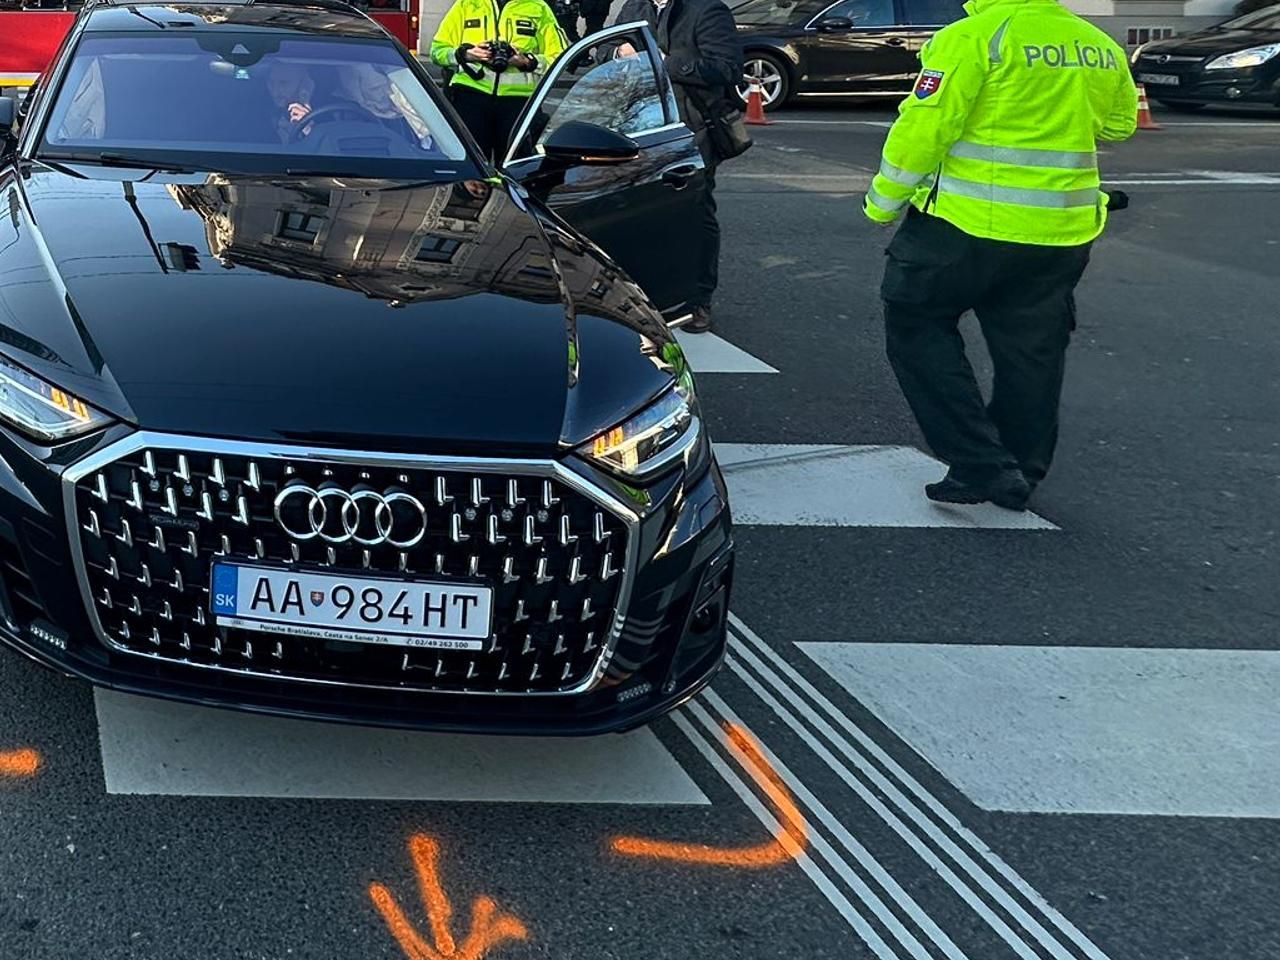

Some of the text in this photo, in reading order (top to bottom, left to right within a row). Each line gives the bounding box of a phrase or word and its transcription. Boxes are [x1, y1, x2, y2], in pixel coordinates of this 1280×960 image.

[1023, 40, 1118, 71] POLÍCIA
[216, 594, 234, 607] SK
[260, 624, 286, 633] Porsche
